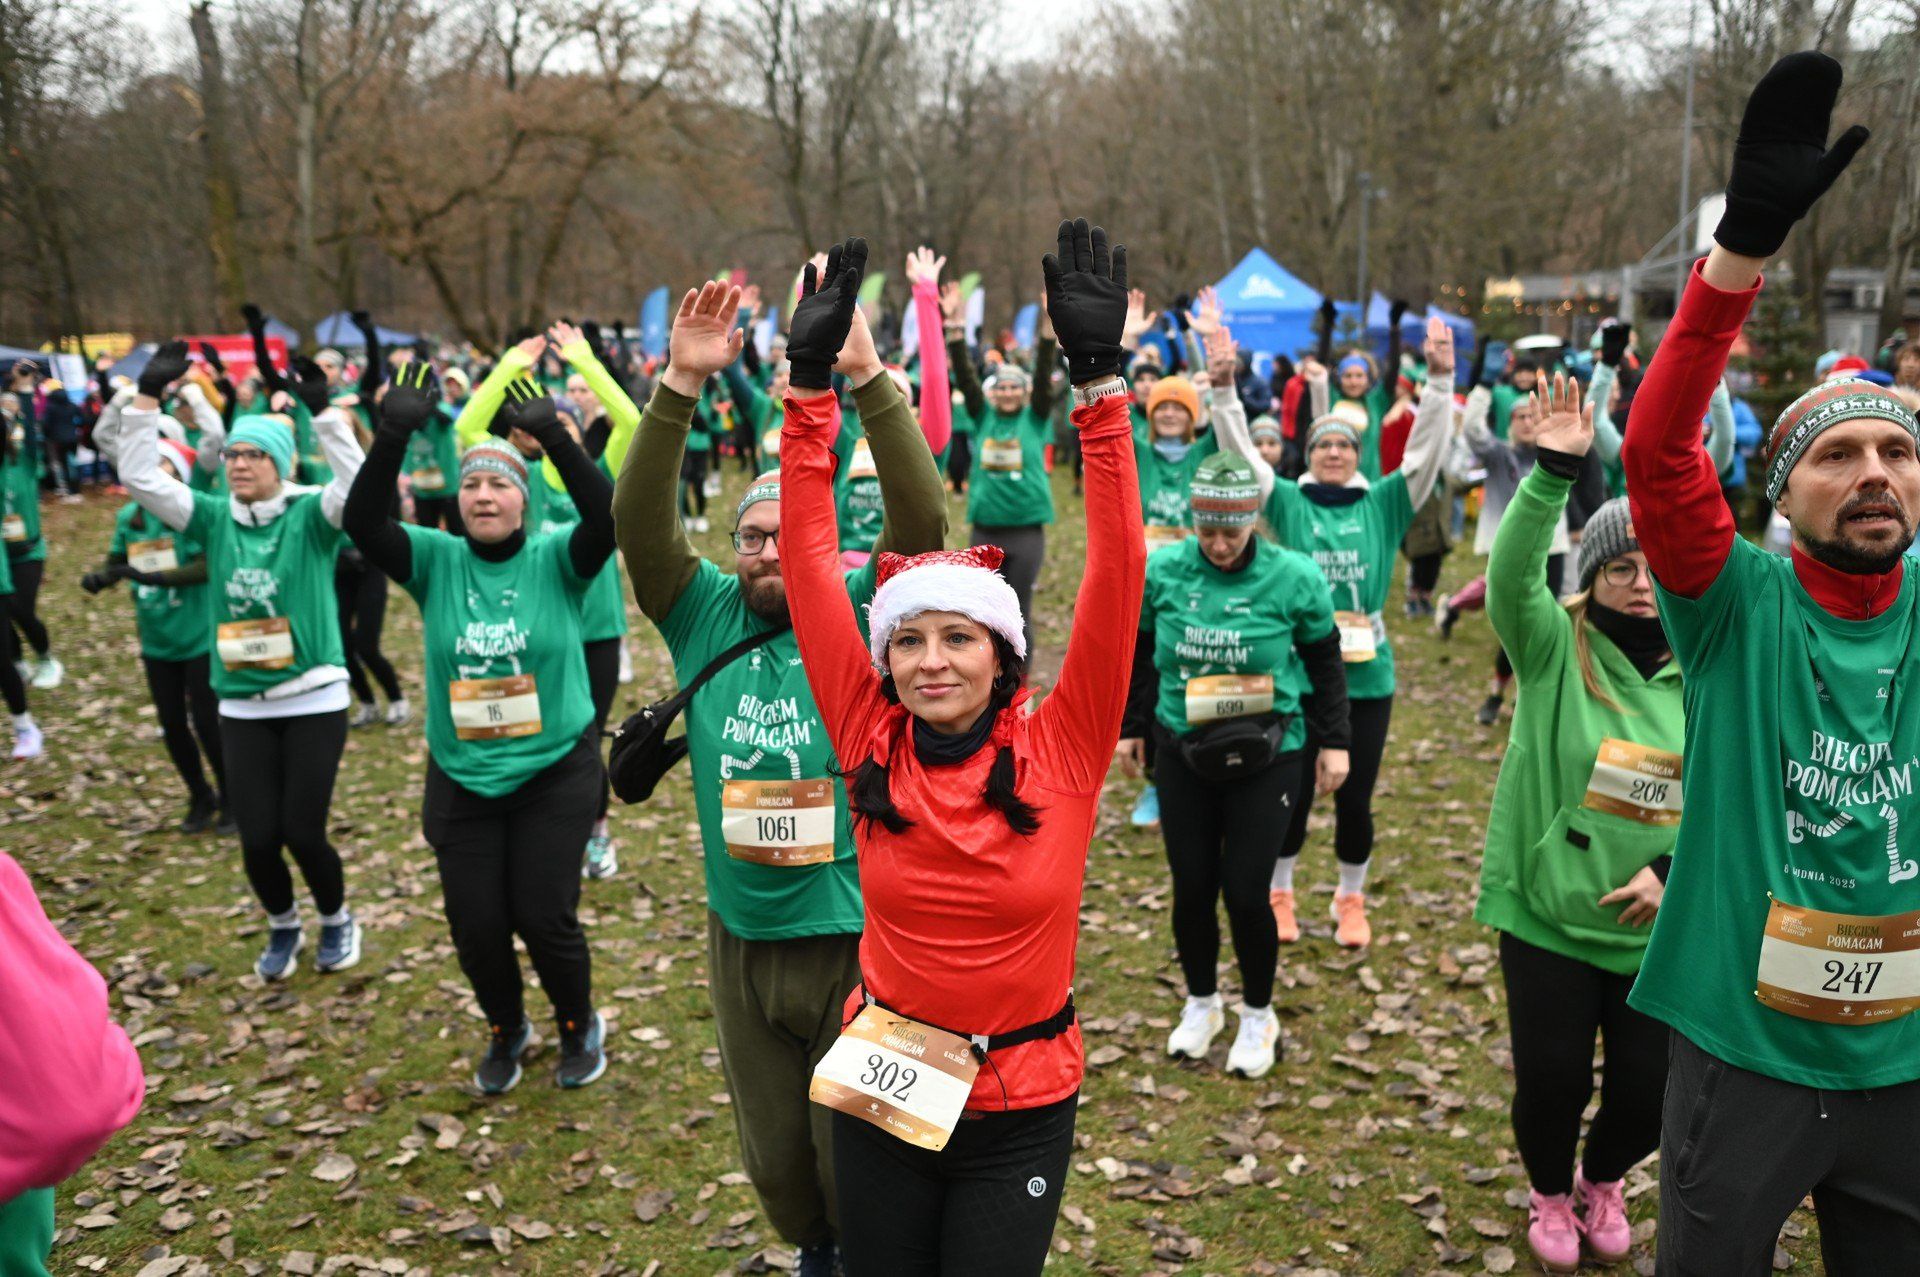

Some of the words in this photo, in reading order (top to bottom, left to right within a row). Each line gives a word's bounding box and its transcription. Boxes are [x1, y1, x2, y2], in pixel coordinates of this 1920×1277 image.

[1184, 625, 1241, 647] BIEGIEM
[487, 703, 502, 722] 16
[1216, 700, 1243, 716] 699
[1637, 761, 1675, 777] POMAGAM
[1629, 778, 1669, 804] 206
[1785, 759, 1913, 808] POMAGAM
[756, 796, 793, 807] POMAGAM
[756, 816, 796, 841] 1061
[1837, 923, 1880, 937] BIEGIEM
[1826, 934, 1883, 950] POMAGAM
[1821, 960, 1884, 995] 247
[892, 1025, 927, 1043] BIEGIEM
[880, 1034, 927, 1058] POMAGAM
[860, 1053, 918, 1103] 302
